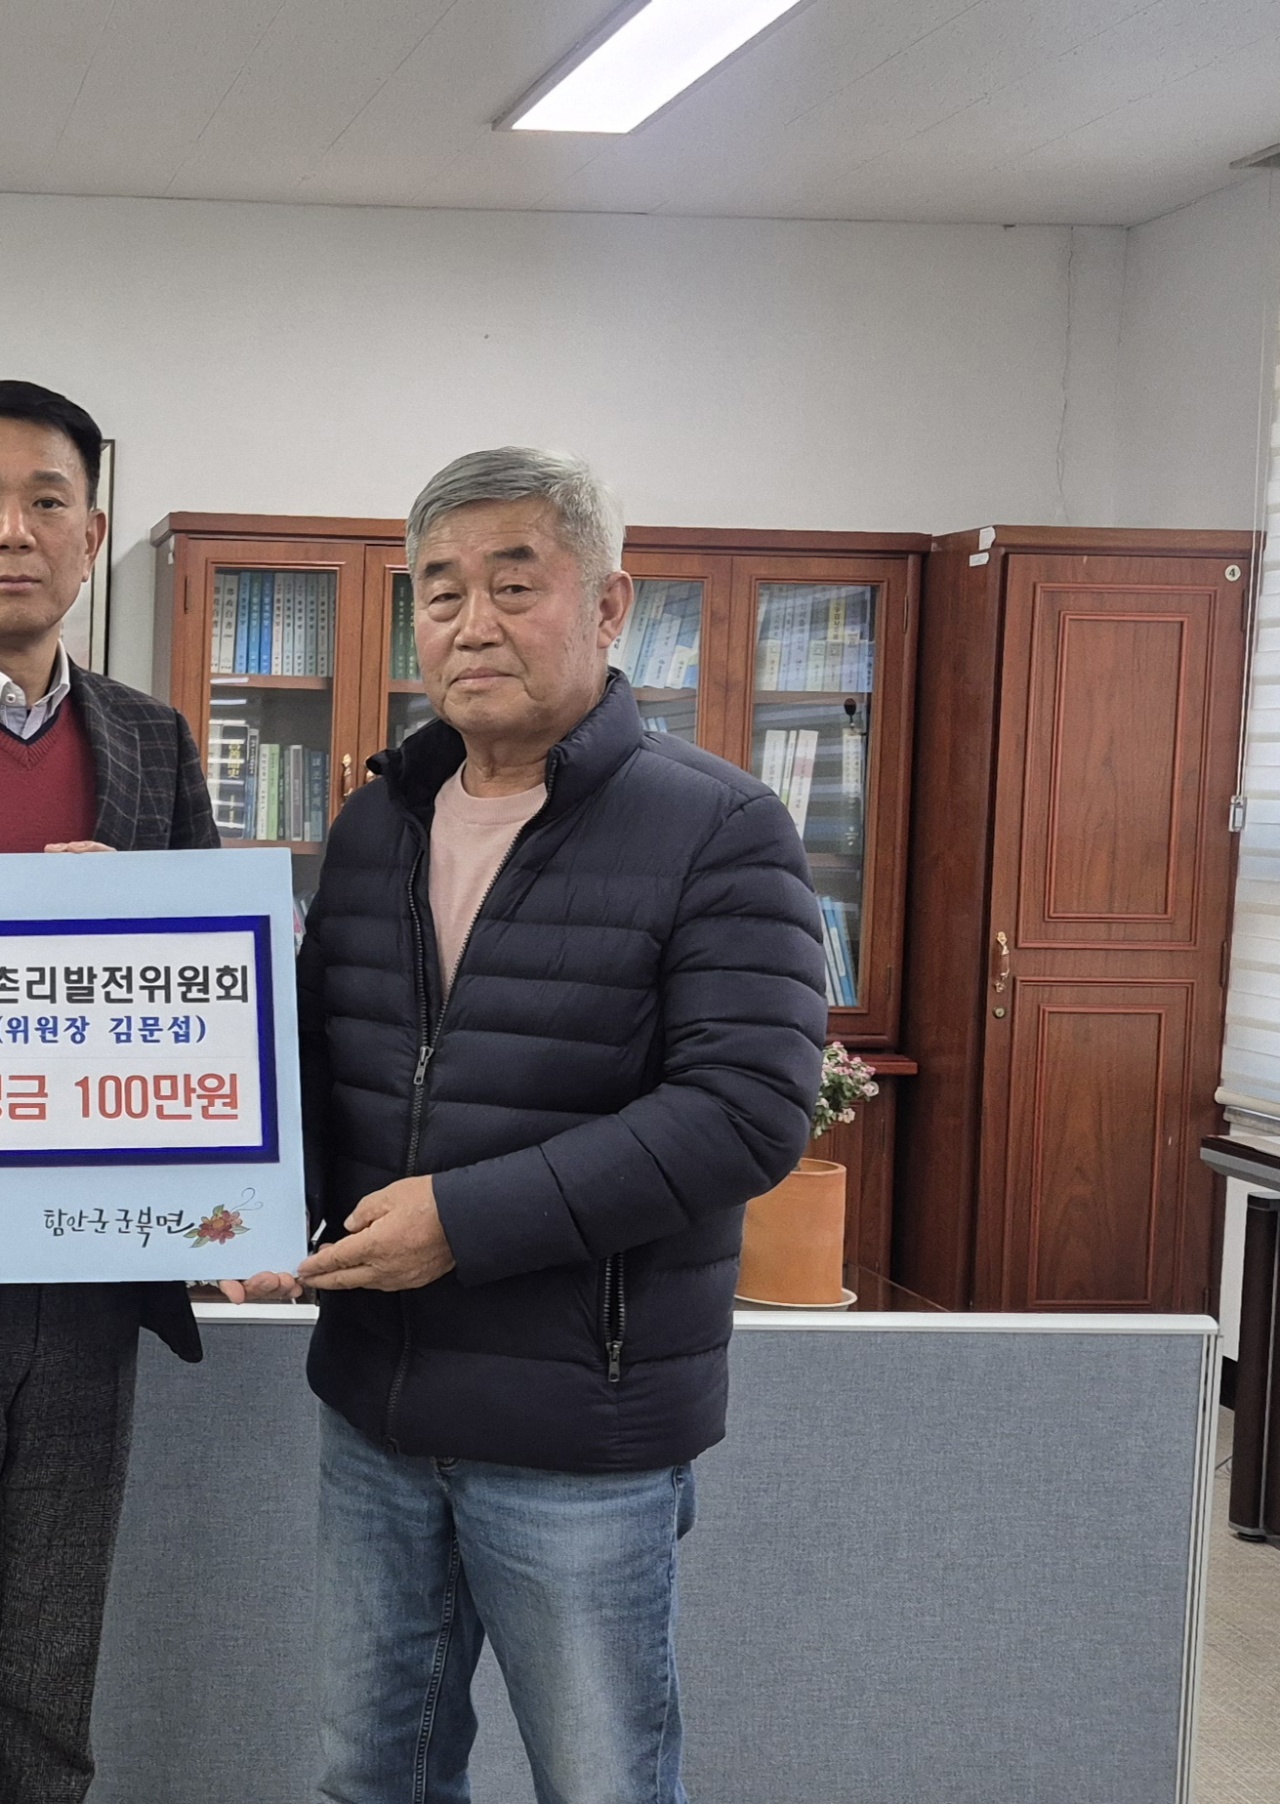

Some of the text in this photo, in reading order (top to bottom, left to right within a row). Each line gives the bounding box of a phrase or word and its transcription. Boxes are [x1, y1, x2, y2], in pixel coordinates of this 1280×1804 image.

[109, 1015, 206, 1044] 김문섭)
[74, 1073, 239, 1120] 100만원
[43, 1206, 195, 1248] 함안군 군북면
